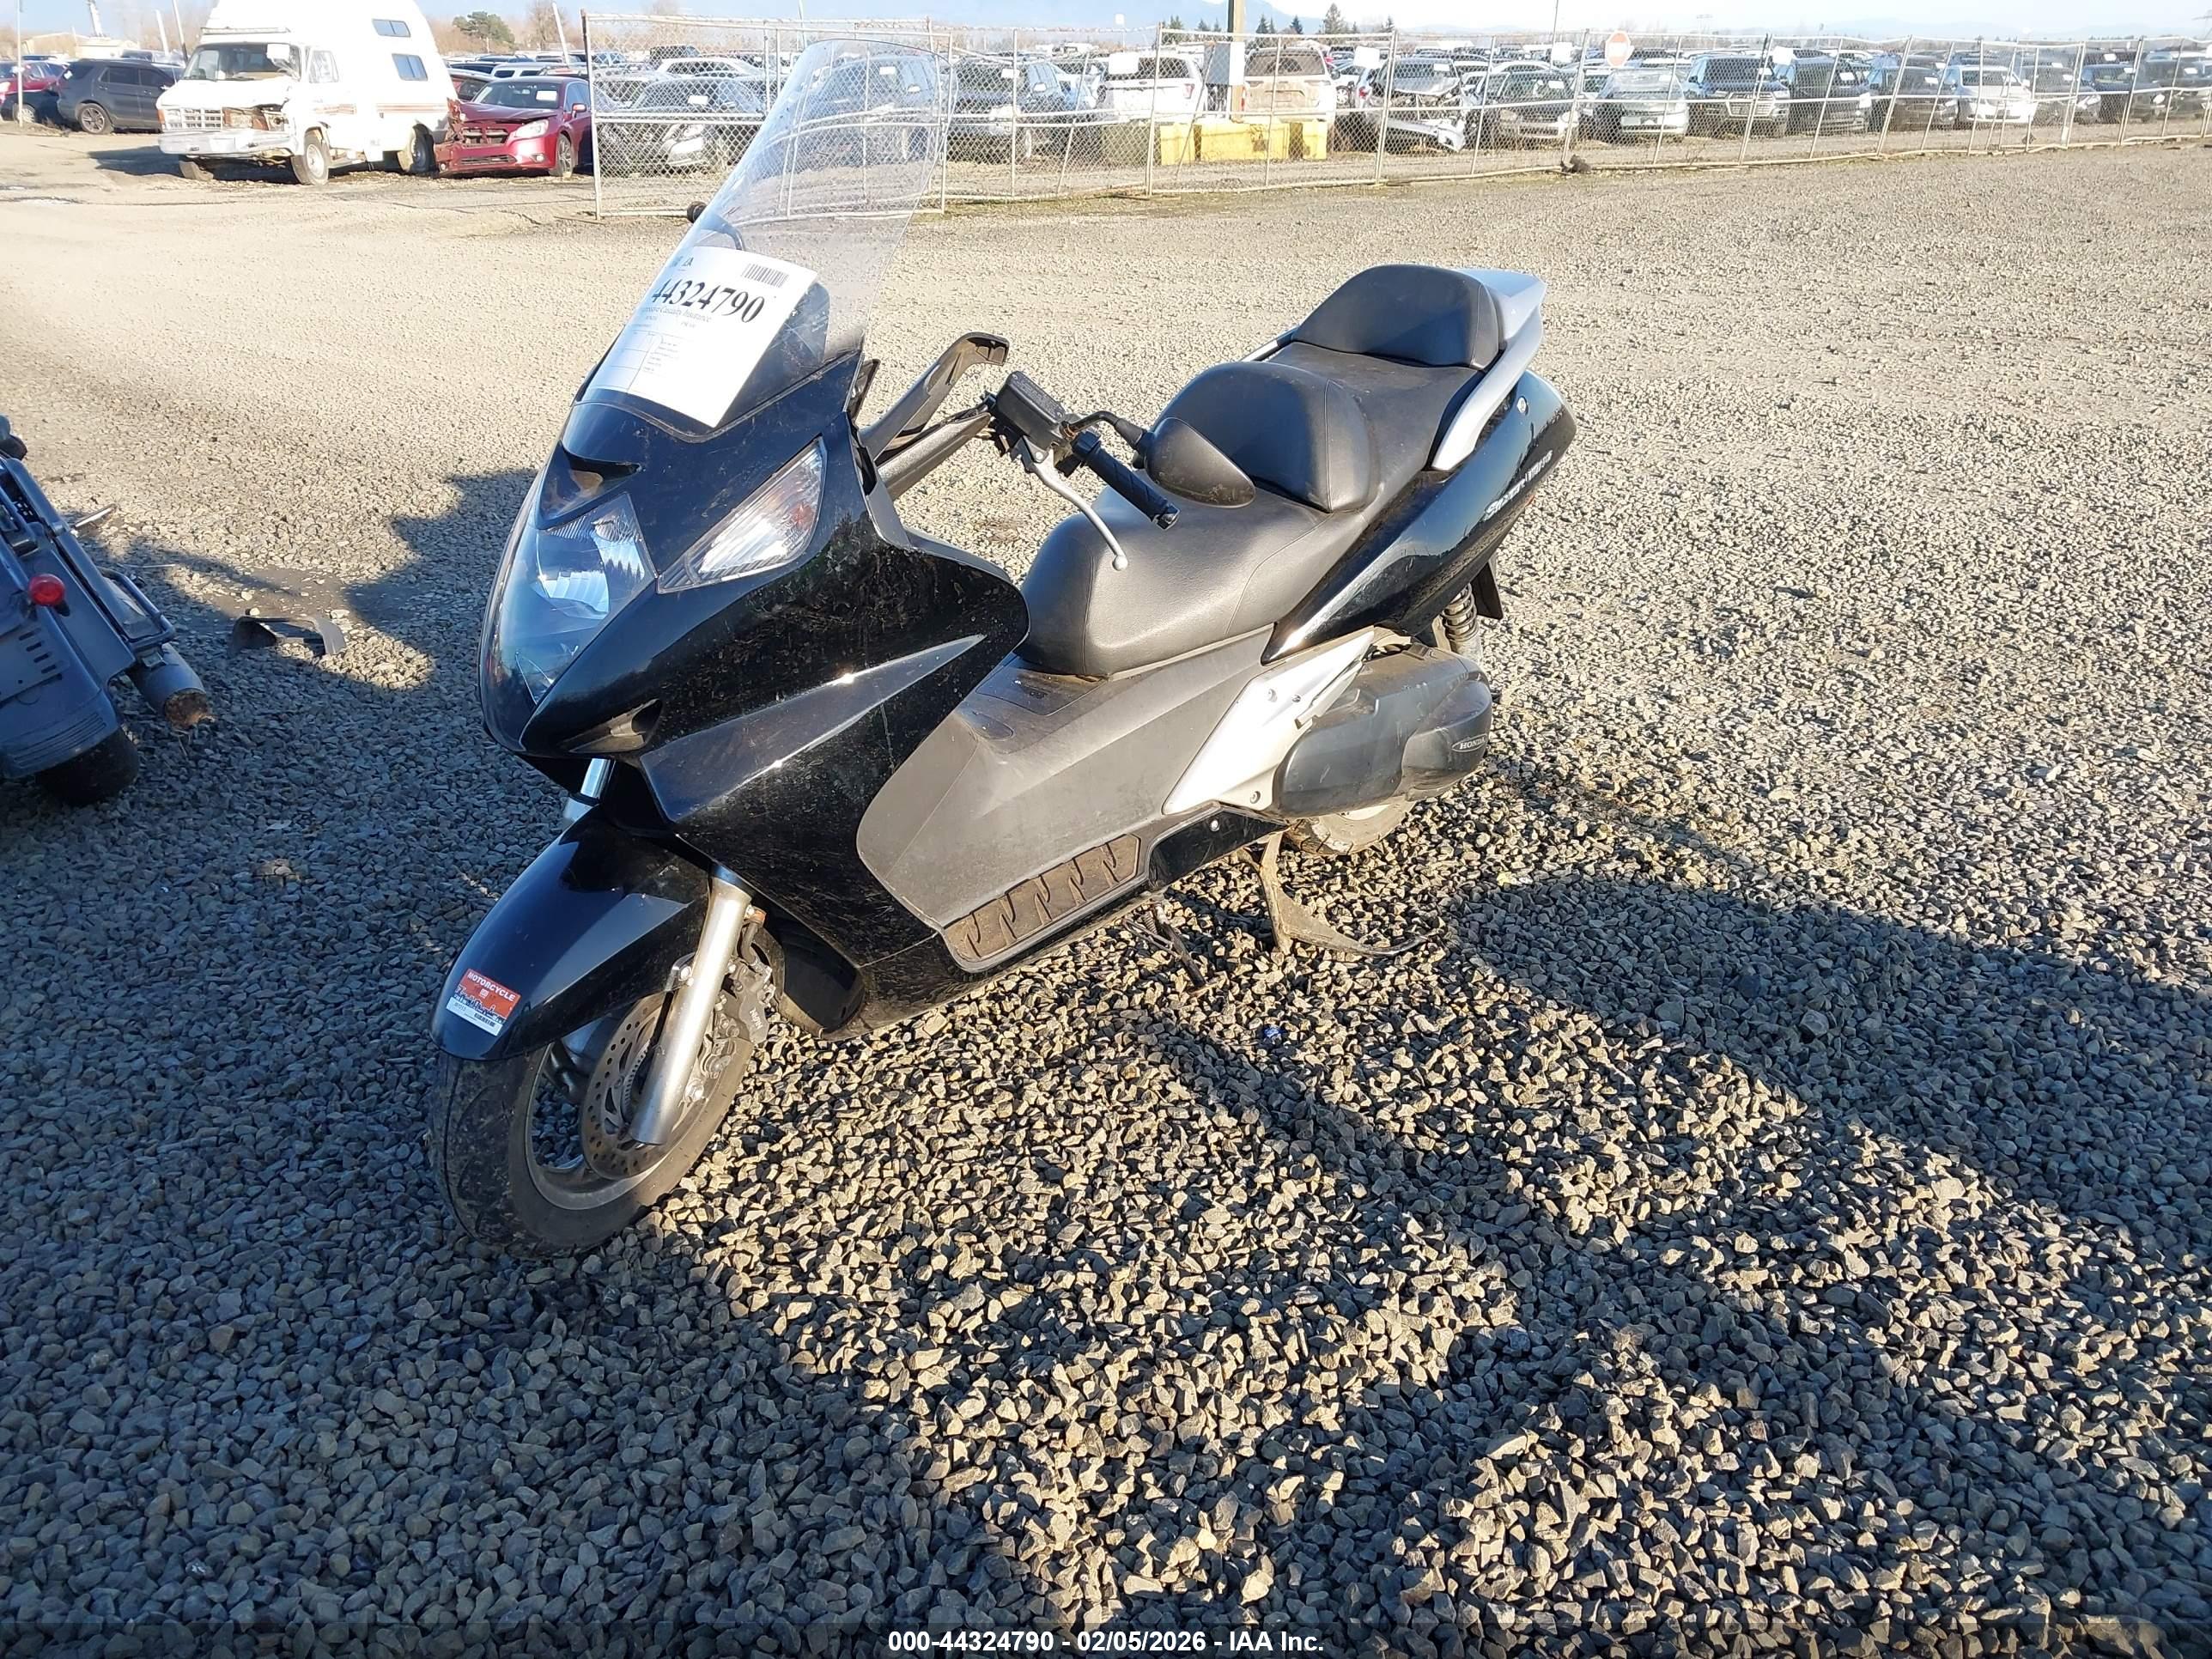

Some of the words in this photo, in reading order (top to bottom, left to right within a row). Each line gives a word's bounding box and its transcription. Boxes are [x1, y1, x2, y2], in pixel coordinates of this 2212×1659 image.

[652, 277, 765, 324] 44324790
[1459, 737, 1486, 750] HONDA
[467, 971, 516, 1002] MOTORCYCLE
